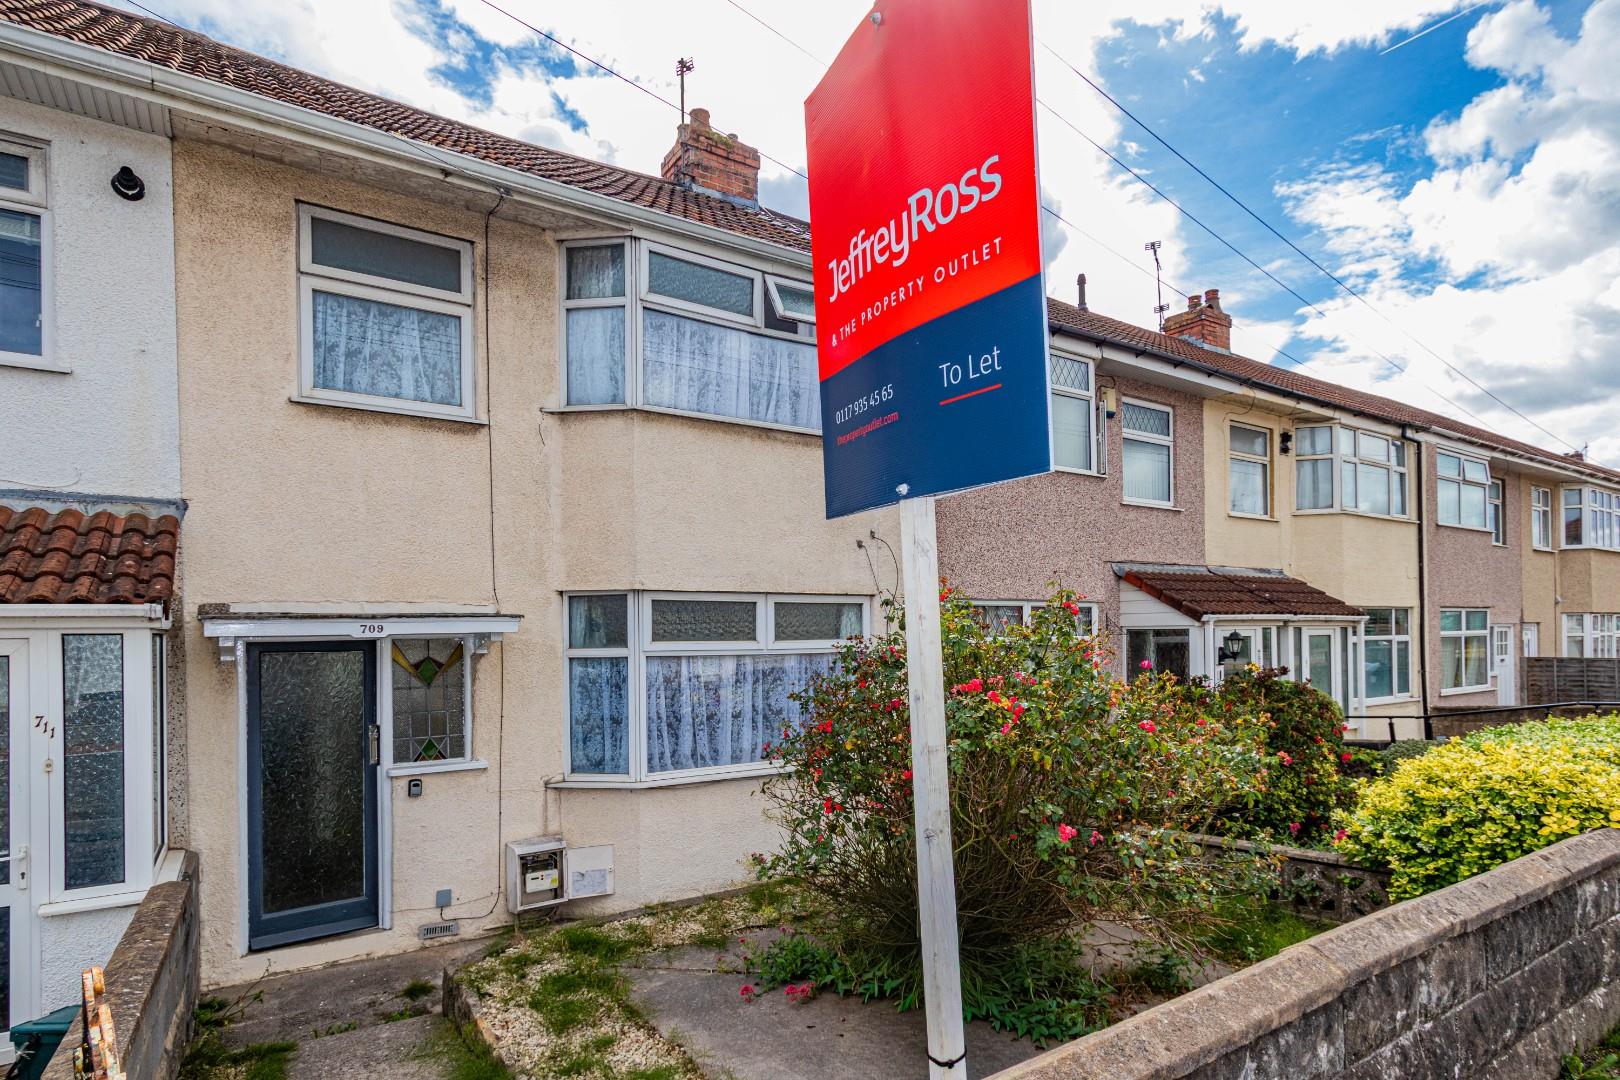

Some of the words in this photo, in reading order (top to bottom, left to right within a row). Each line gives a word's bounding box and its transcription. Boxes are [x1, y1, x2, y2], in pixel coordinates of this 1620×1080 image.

[831, 333, 838, 347] &
[840, 318, 857, 341] THE
[861, 275, 924, 326] PROPERTY
[933, 236, 1002, 283] OUTLET
[938, 362, 962, 388] To
[968, 345, 1002, 379] Let
[835, 403, 853, 425] 0117
[854, 396, 868, 416] 935
[869, 390, 880, 407] 45
[881, 383, 894, 402] 65
[359, 624, 384, 634] 709
[34, 715, 55, 739] 711
